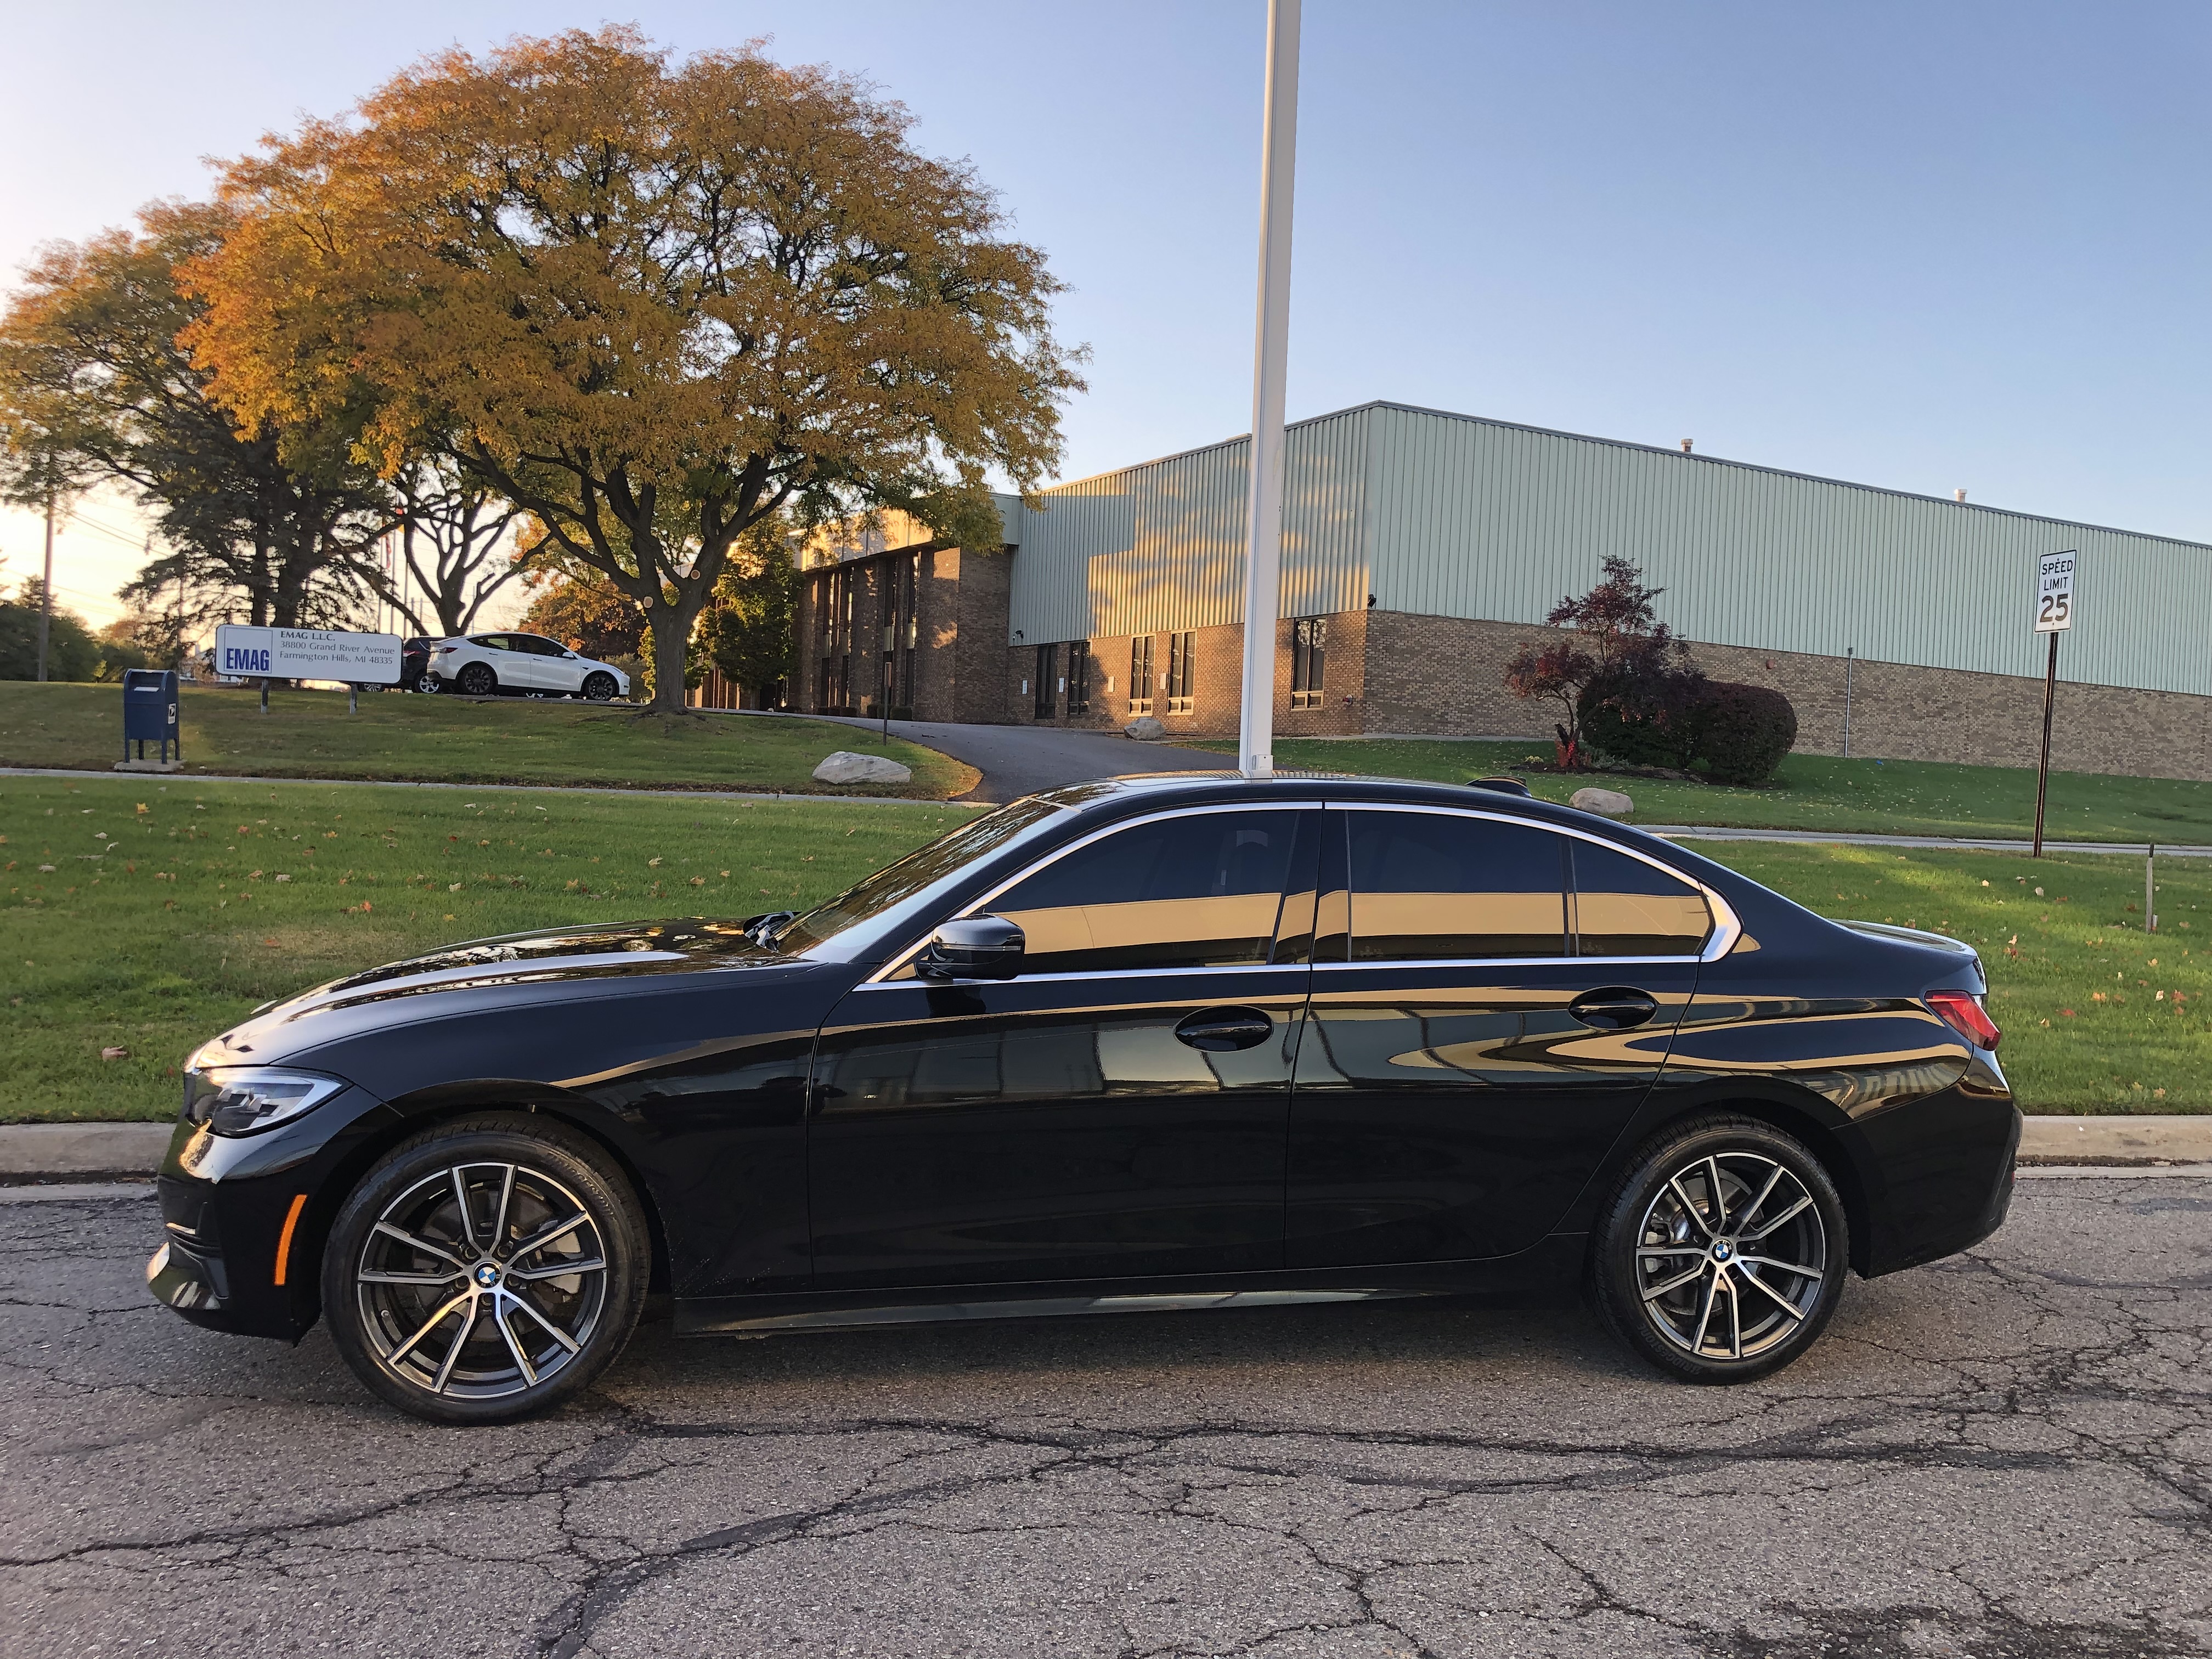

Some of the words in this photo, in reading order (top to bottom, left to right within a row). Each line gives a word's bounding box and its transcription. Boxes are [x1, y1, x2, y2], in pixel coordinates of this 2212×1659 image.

[2041, 560, 2073, 575] SPEED
[2044, 577, 2068, 591] LIMIT
[2040, 593, 2068, 623] 25
[281, 630, 308, 639] EMAG
[280, 641, 306, 649] 38800
[309, 642, 336, 651] Grand
[340, 644, 360, 652] River
[364, 646, 395, 654] Avenue
[225, 647, 270, 672] EMAG
[280, 651, 328, 662] Farmington
[332, 654, 352, 663] Hills,
[369, 656, 393, 664] 48335
